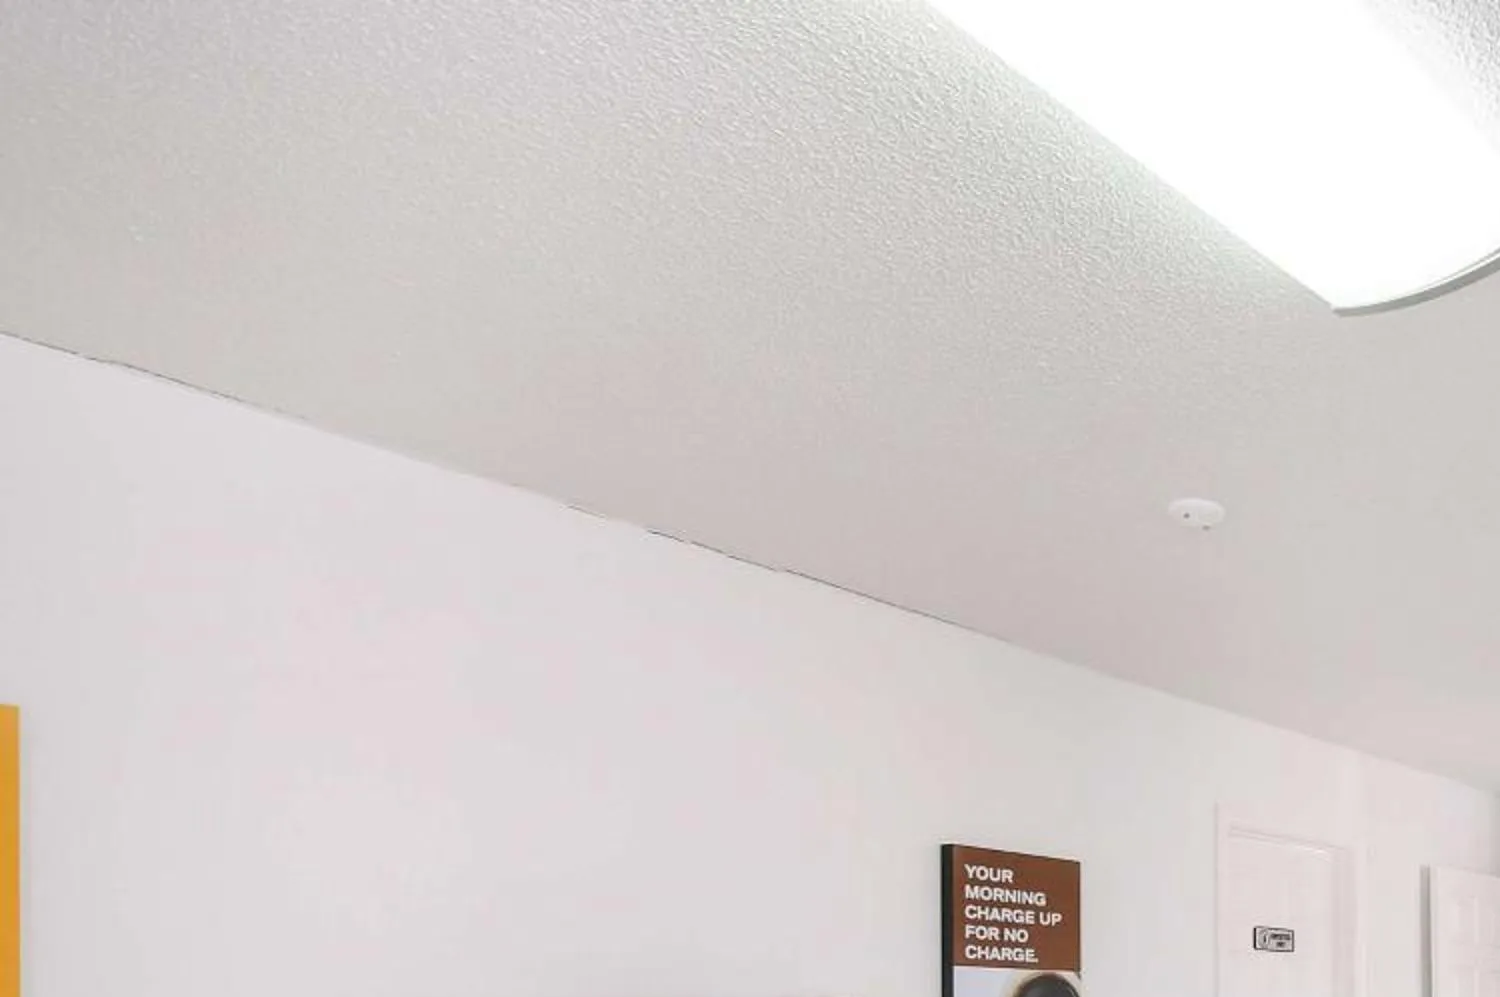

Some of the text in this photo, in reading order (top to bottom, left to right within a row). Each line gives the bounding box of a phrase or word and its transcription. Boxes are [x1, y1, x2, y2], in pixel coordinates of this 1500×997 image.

[964, 864, 1013, 883] YOUR
[964, 884, 1047, 906] MORNING
[964, 905, 1062, 926] CHARGE UP
[964, 924, 1029, 943] FOR NO
[965, 945, 1039, 963] CHARGE.
